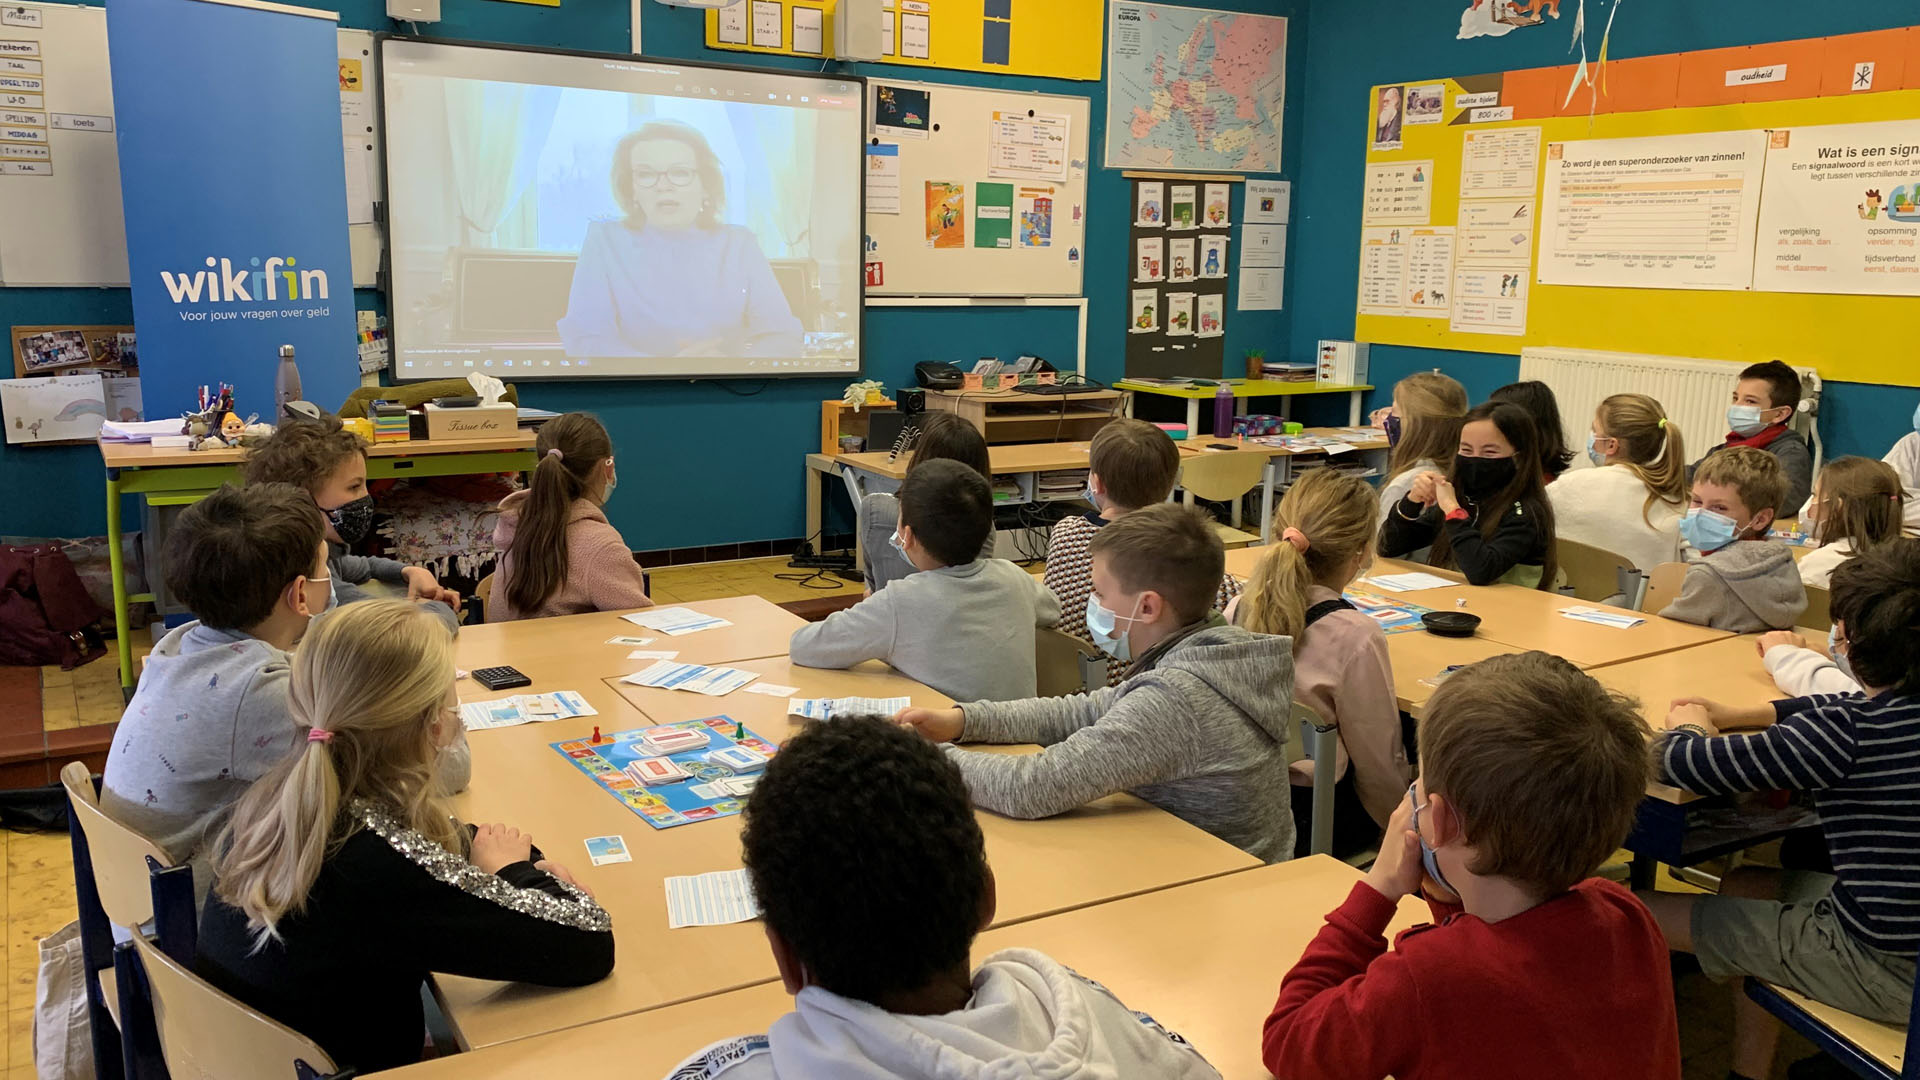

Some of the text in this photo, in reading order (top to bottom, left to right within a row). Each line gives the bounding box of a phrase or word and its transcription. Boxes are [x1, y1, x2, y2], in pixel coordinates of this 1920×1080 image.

[1741, 69, 1773, 81] oudheid
[5, 114, 37, 123] SPELLING
[1477, 110, 1491, 119] 800
[73, 119, 95, 127] toets
[1818, 147, 1842, 159] Wat
[1846, 147, 1857, 157] is
[1861, 147, 1886, 157] een
[1562, 160, 1571, 168] Zo
[1573, 159, 1592, 168] word
[1593, 159, 1601, 169] je
[1602, 159, 1617, 167] een
[1618, 154, 1693, 167] superonderzoeker
[1711, 151, 1745, 161] zinnen!
[1809, 160, 1866, 171] signaalwoord
[1868, 160, 1875, 168] is
[1811, 173, 1825, 181] legt
[1856, 169, 1908, 179] verschillende
[1778, 228, 1821, 237] vergelijking
[1868, 228, 1917, 237] opsomming
[1864, 254, 1916, 263] tijdsverband
[160, 256, 329, 304] wikifin
[180, 306, 330, 322] Voor jouw vragen over geld
[448, 419, 499, 431] Tissue box
[714, 1046, 746, 1069] SPACE
